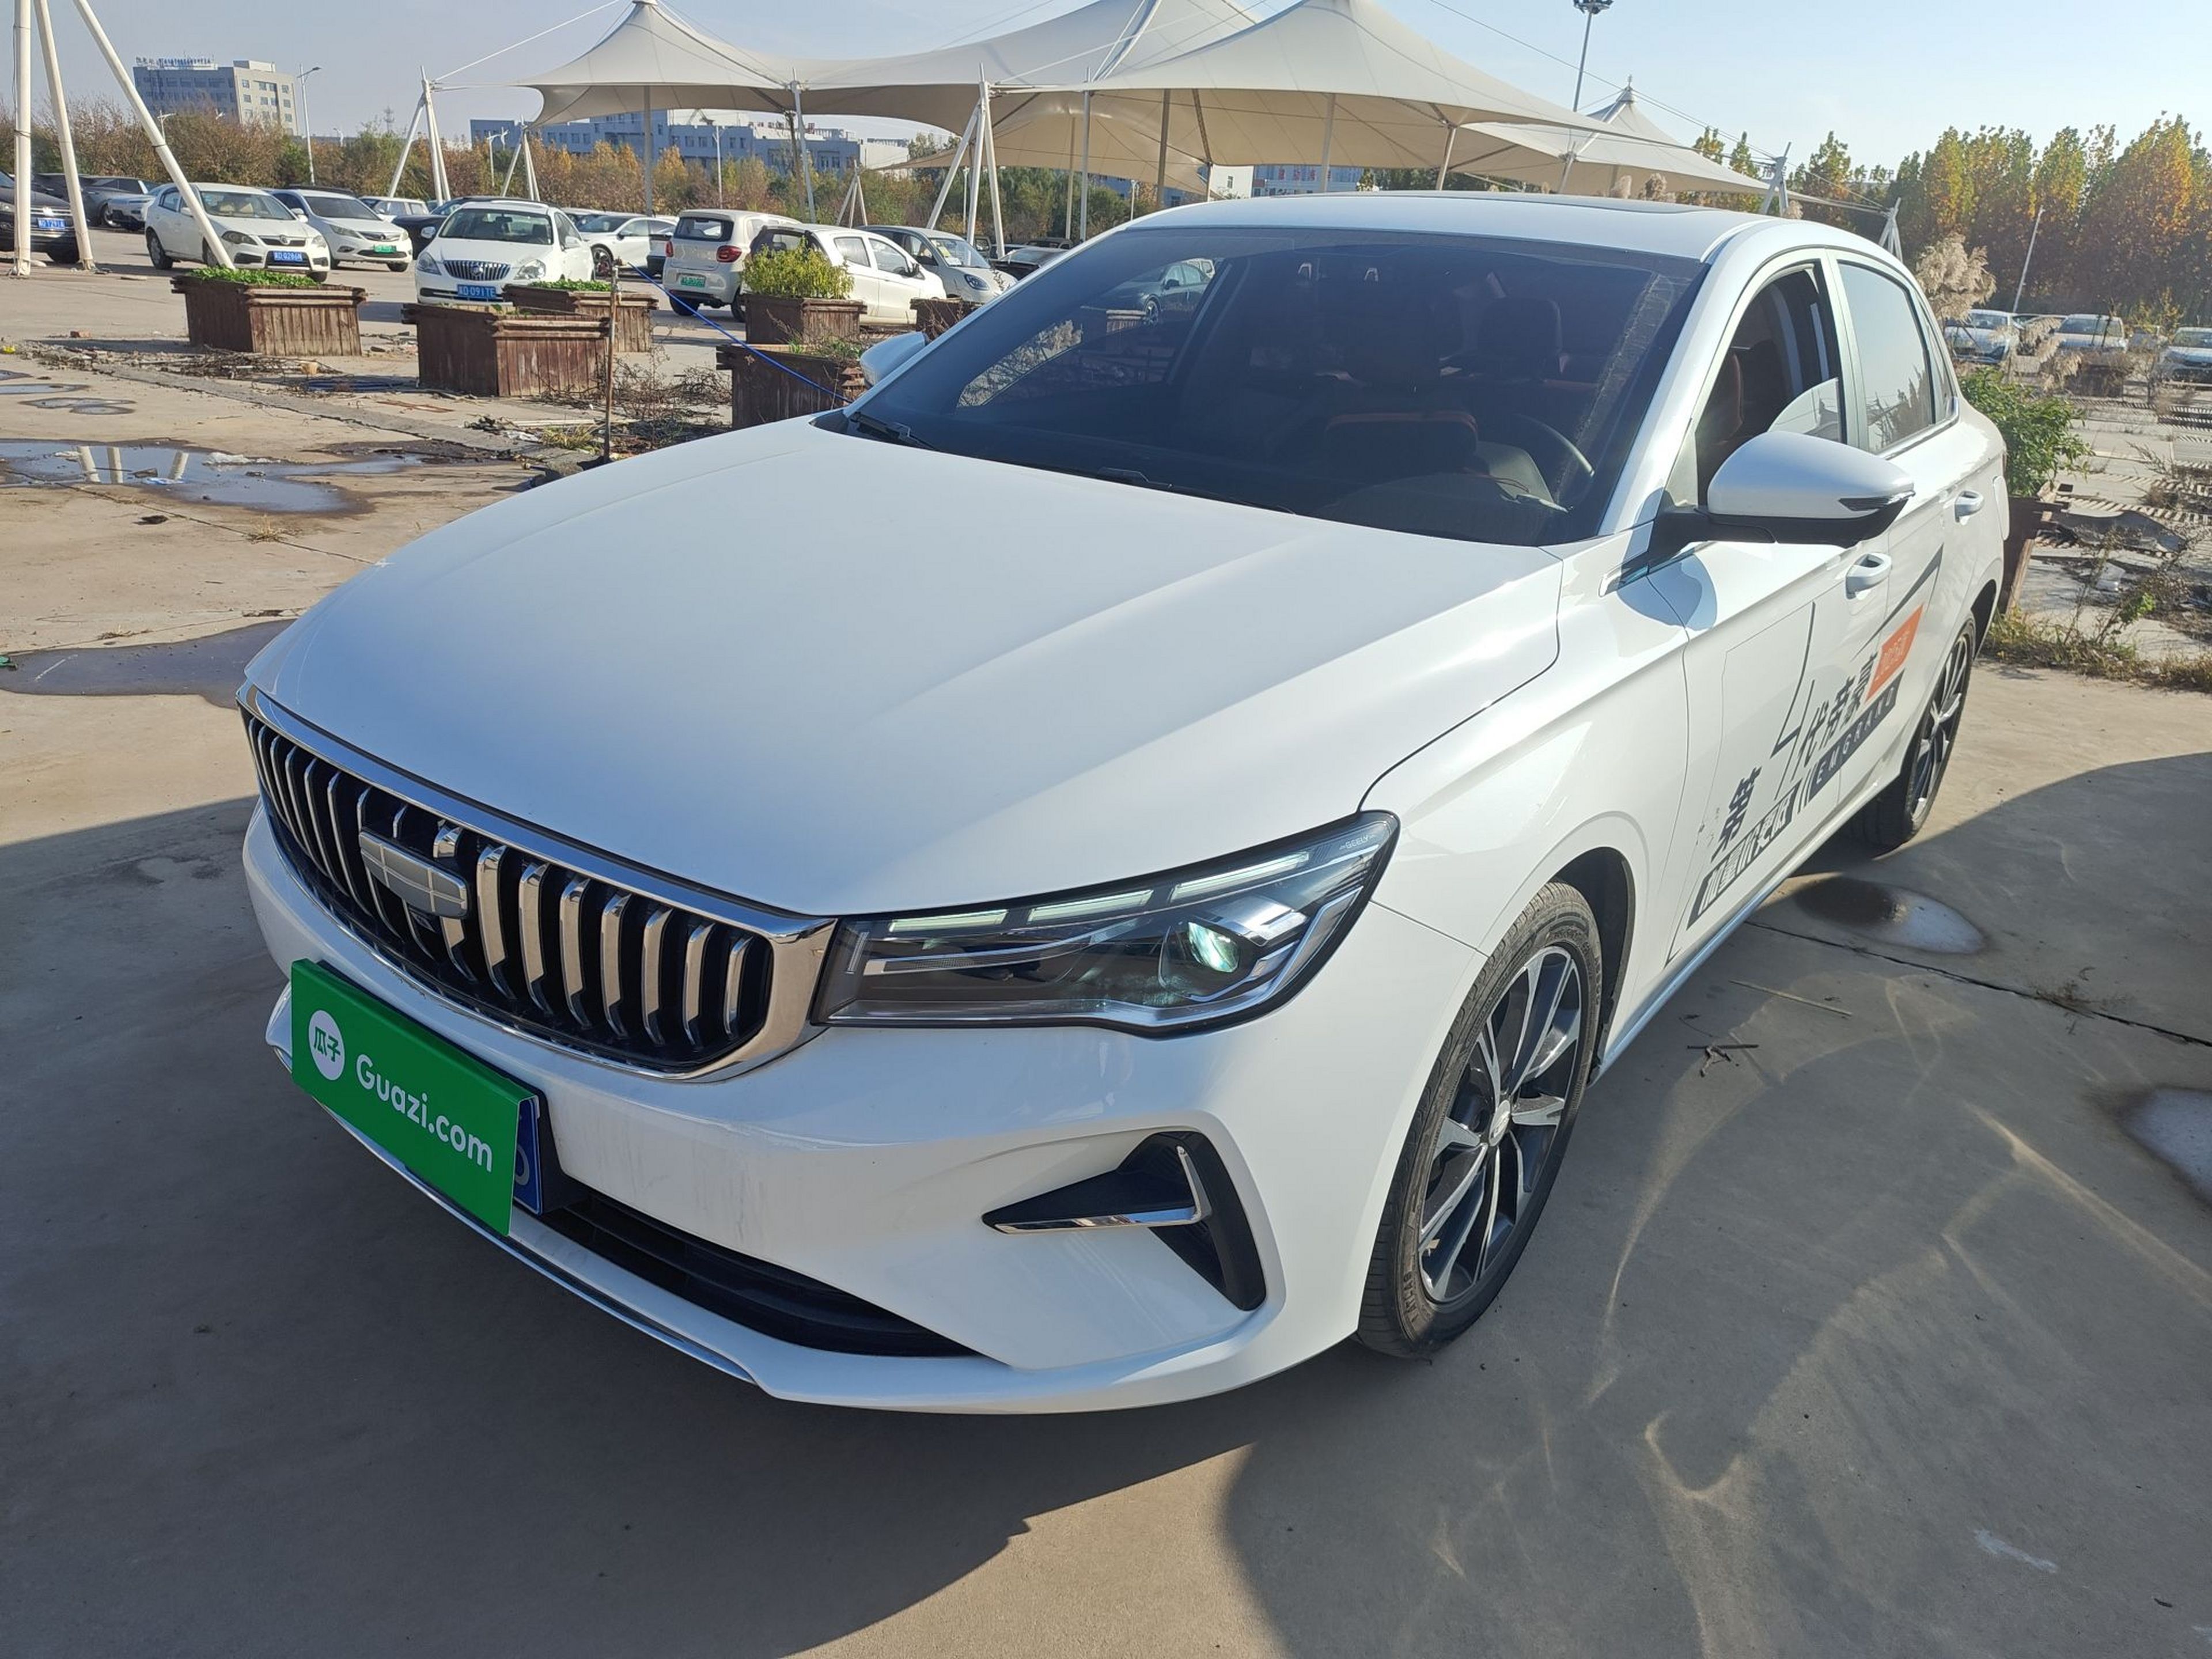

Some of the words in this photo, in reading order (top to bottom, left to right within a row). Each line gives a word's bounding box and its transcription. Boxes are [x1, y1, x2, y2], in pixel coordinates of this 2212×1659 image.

[1816, 686, 1895, 785] EMGRAND
[1345, 834, 1369, 849] GEELY
[313, 1025, 341, 1064] 瓜子
[355, 1054, 493, 1173] Guazi.com
